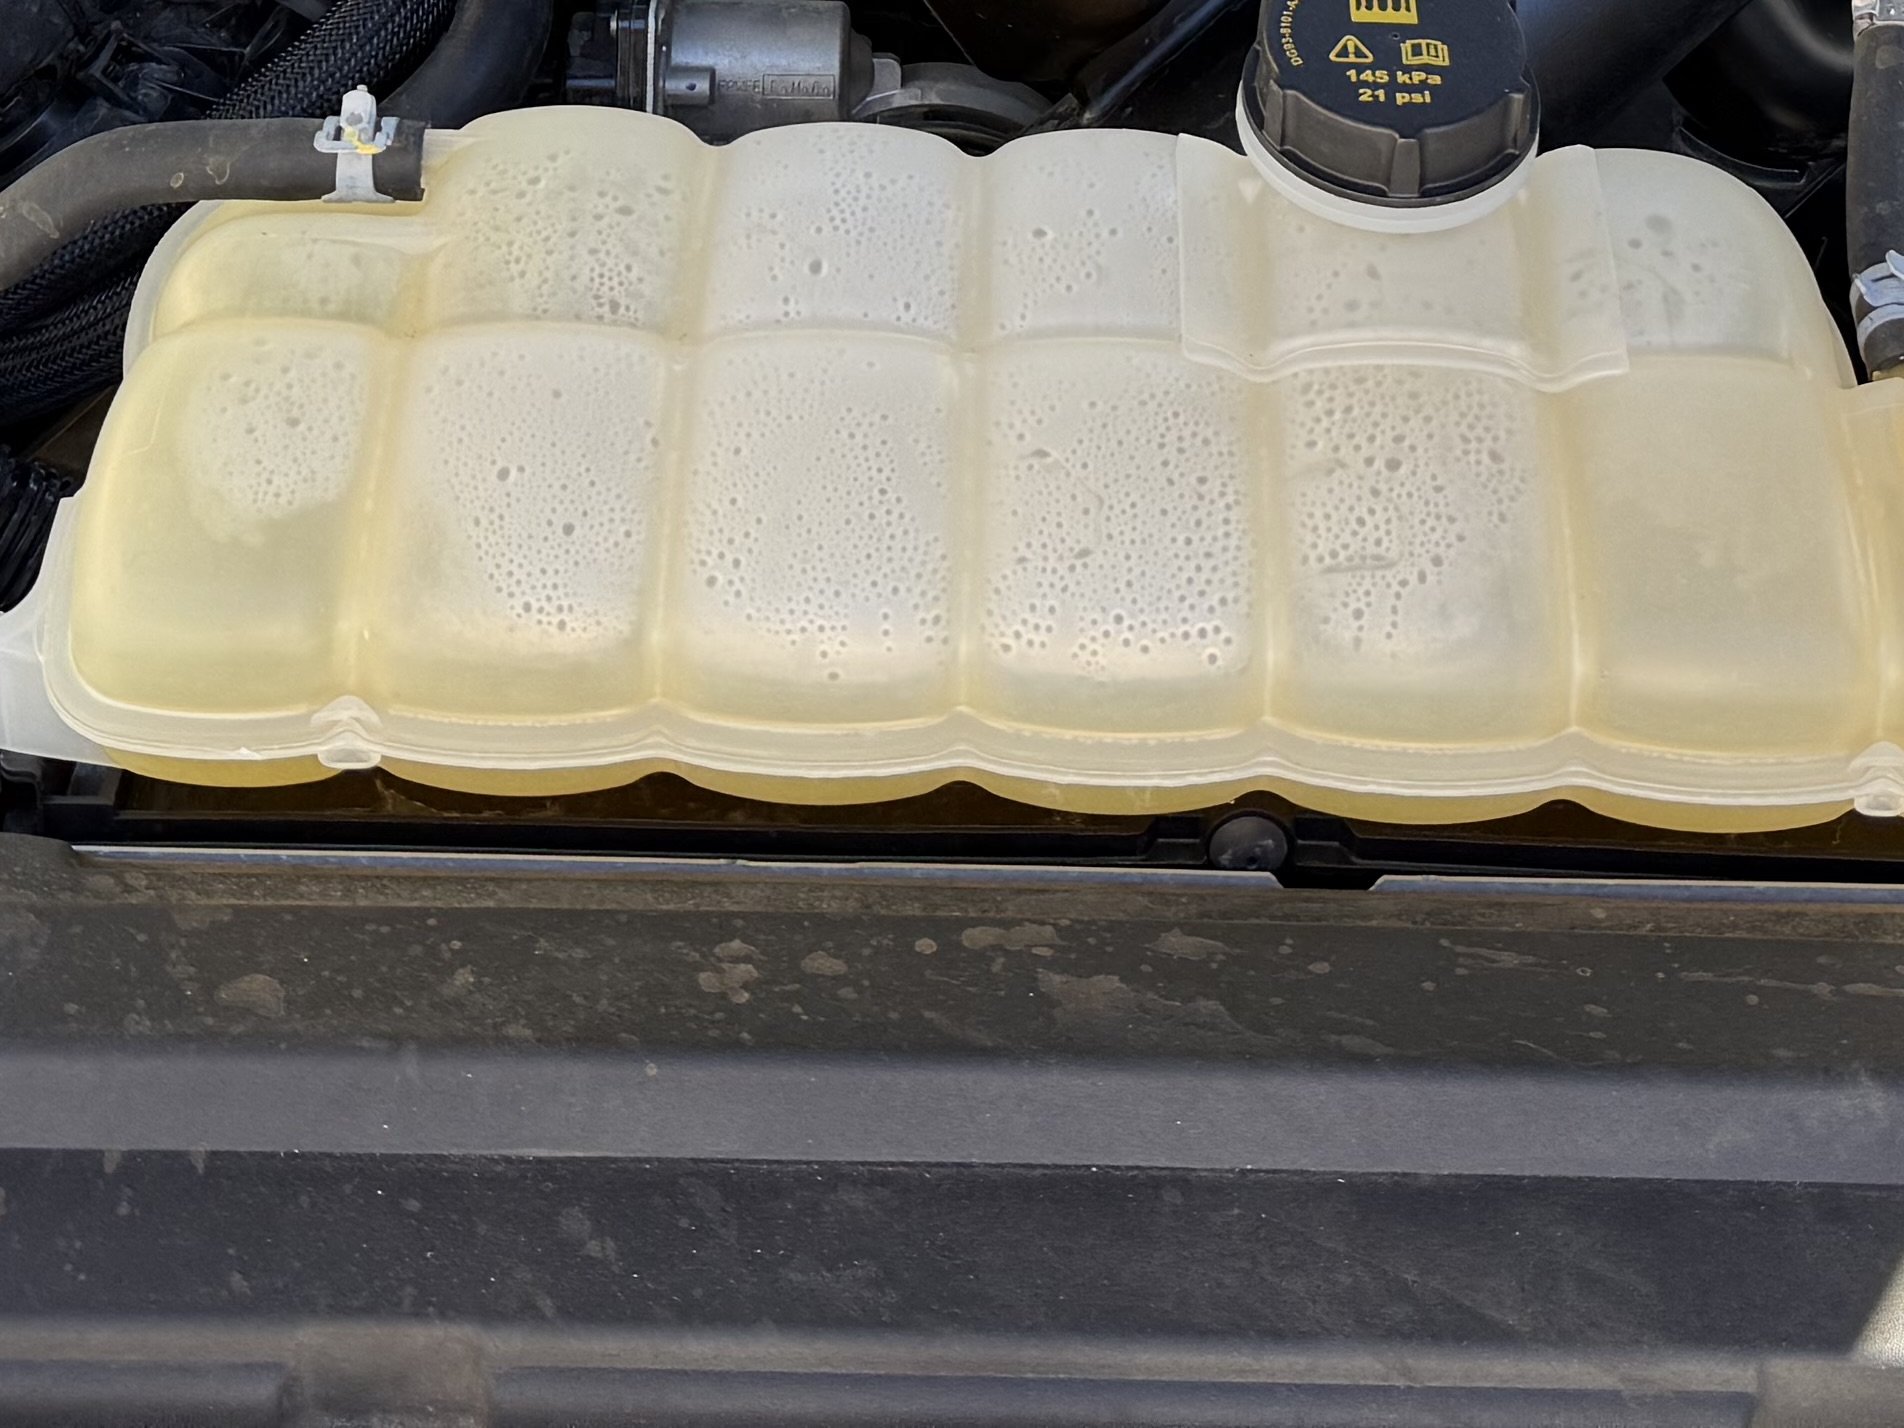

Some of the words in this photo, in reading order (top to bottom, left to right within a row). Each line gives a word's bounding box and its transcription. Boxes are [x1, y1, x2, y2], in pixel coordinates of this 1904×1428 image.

[1346, 69, 1390, 83] 145
[1396, 70, 1442, 85] kPa
[1358, 88, 1386, 102] 21
[1395, 90, 1431, 106] psi
